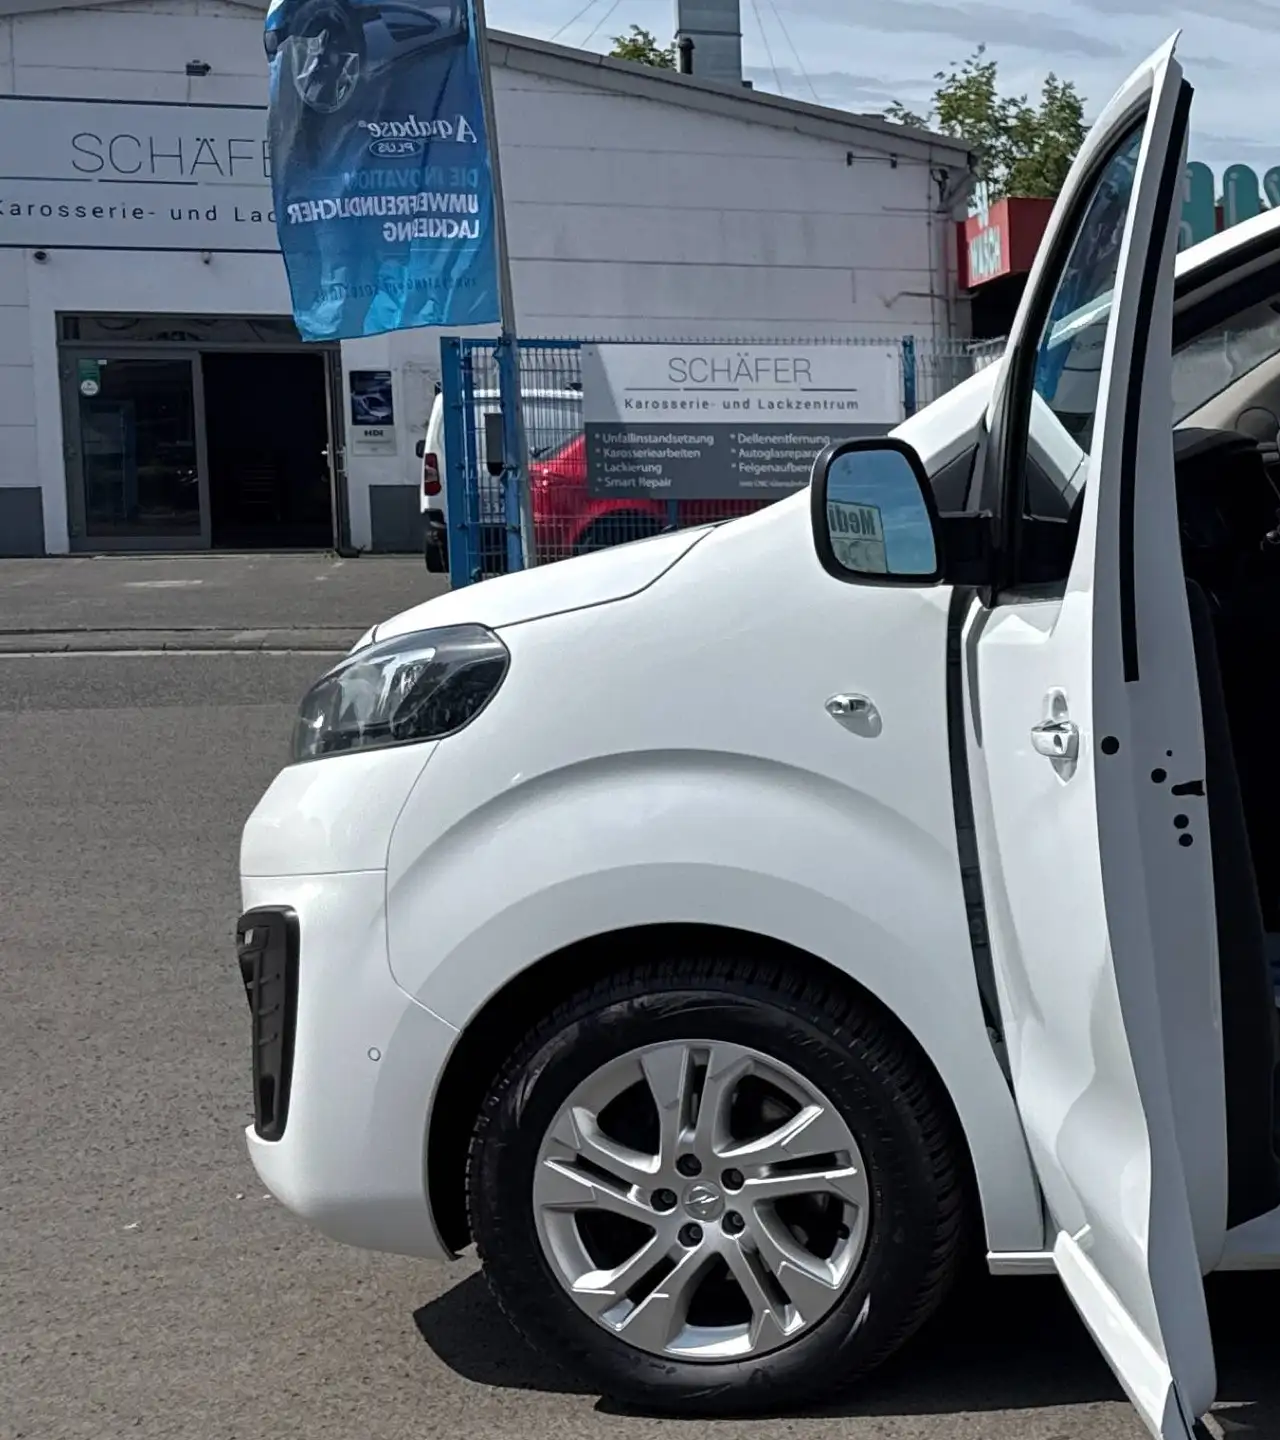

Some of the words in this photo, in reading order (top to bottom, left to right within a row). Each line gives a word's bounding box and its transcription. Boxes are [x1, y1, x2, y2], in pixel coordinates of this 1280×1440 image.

[0, 201, 156, 220] arosserie-
[170, 205, 218, 222] und
[668, 351, 813, 384] SCHÄFER
[624, 397, 717, 411] Karosserie-
[722, 398, 751, 410] und
[758, 398, 860, 411] Lackzentrum
[601, 432, 715, 446] Unfallinstandsetzung
[602, 447, 701, 459] Karosseriearbeiten
[603, 462, 663, 475] Lackierung
[604, 476, 638, 488] Smart
[638, 476, 673, 489] Repair
